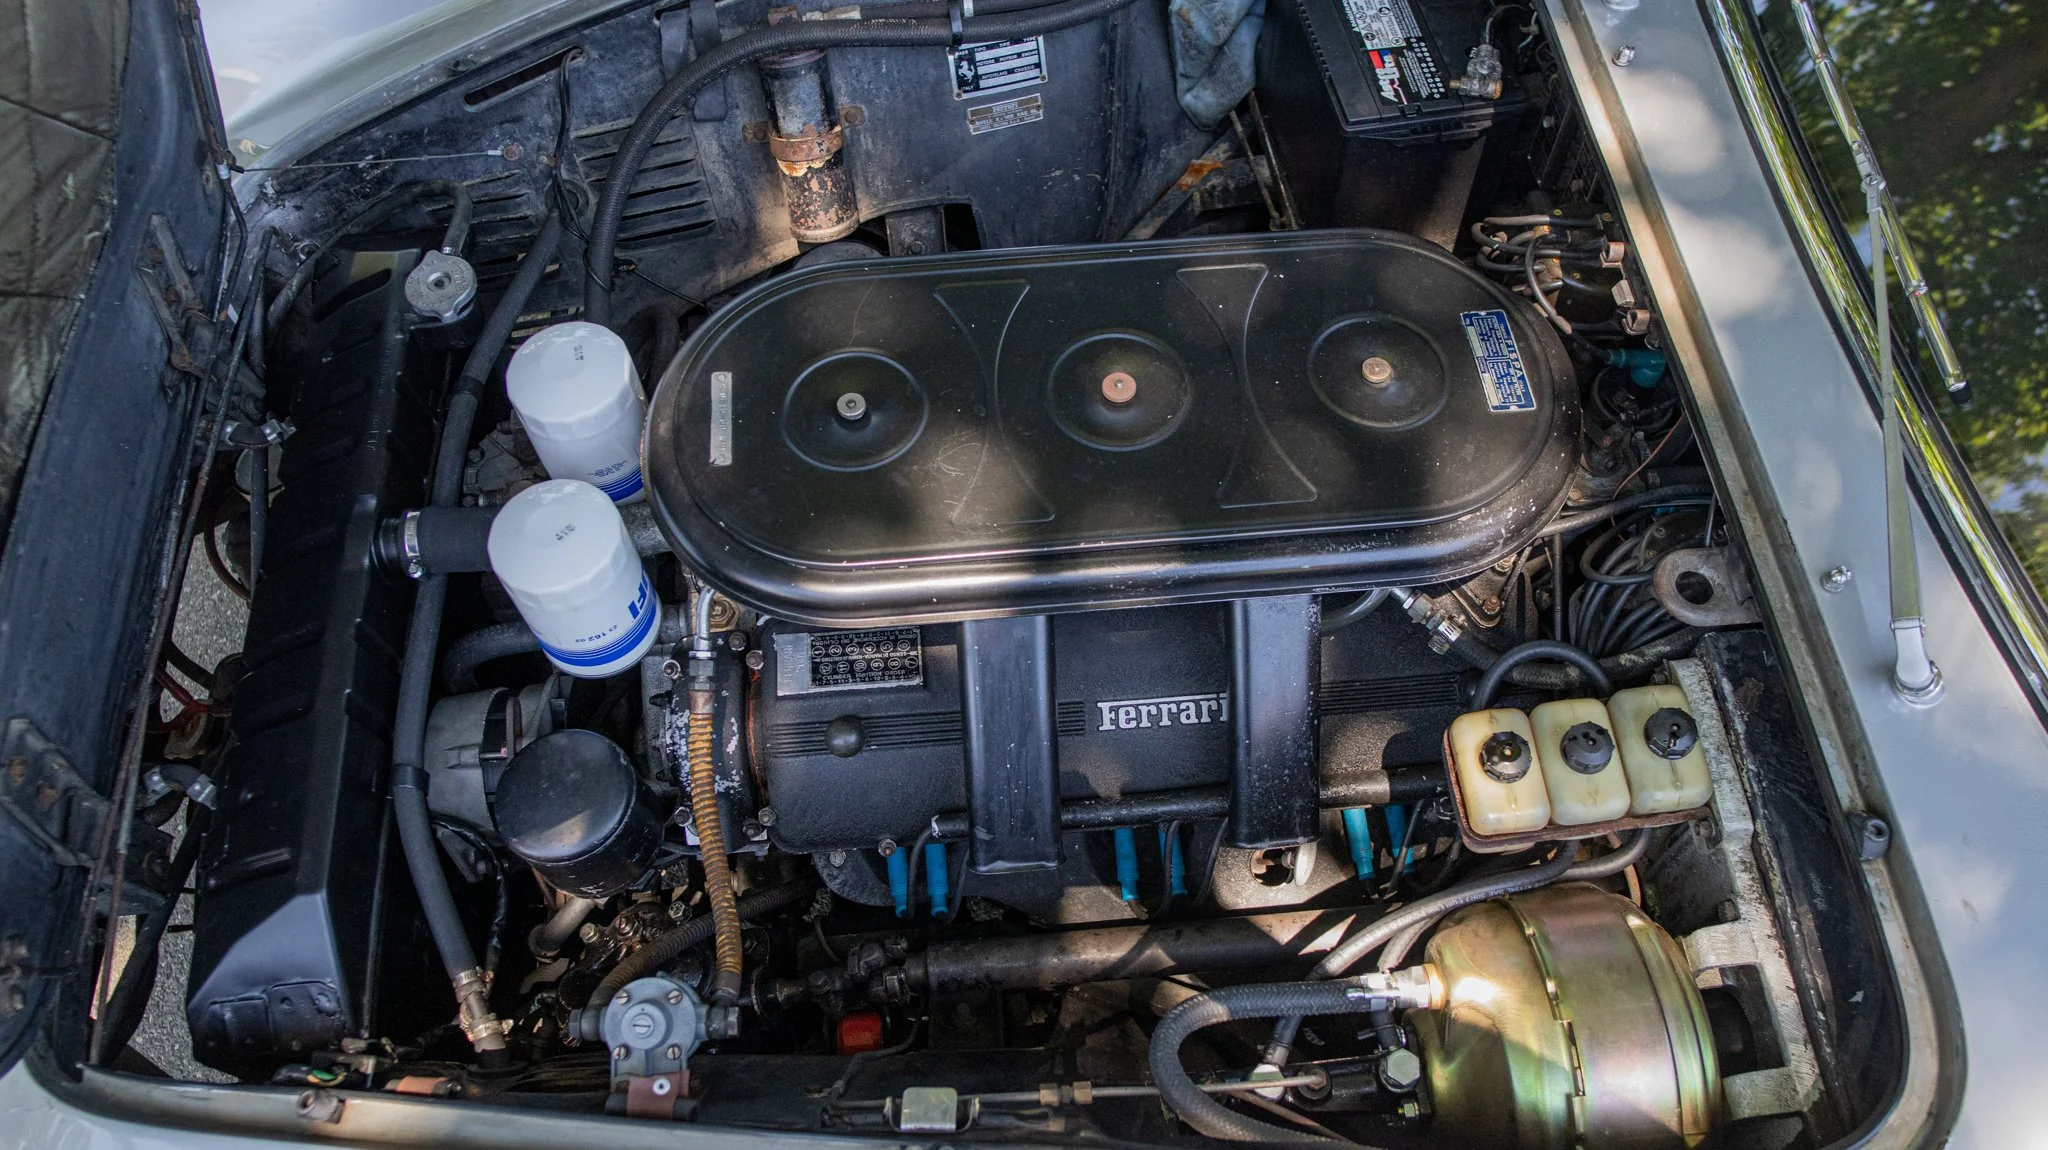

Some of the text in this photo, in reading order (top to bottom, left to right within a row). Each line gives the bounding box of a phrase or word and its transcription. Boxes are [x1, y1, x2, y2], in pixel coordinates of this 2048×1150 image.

[1504, 339, 1523, 377] FISPA
[588, 632, 606, 642] 162
[1097, 692, 1228, 731] Ferrari
